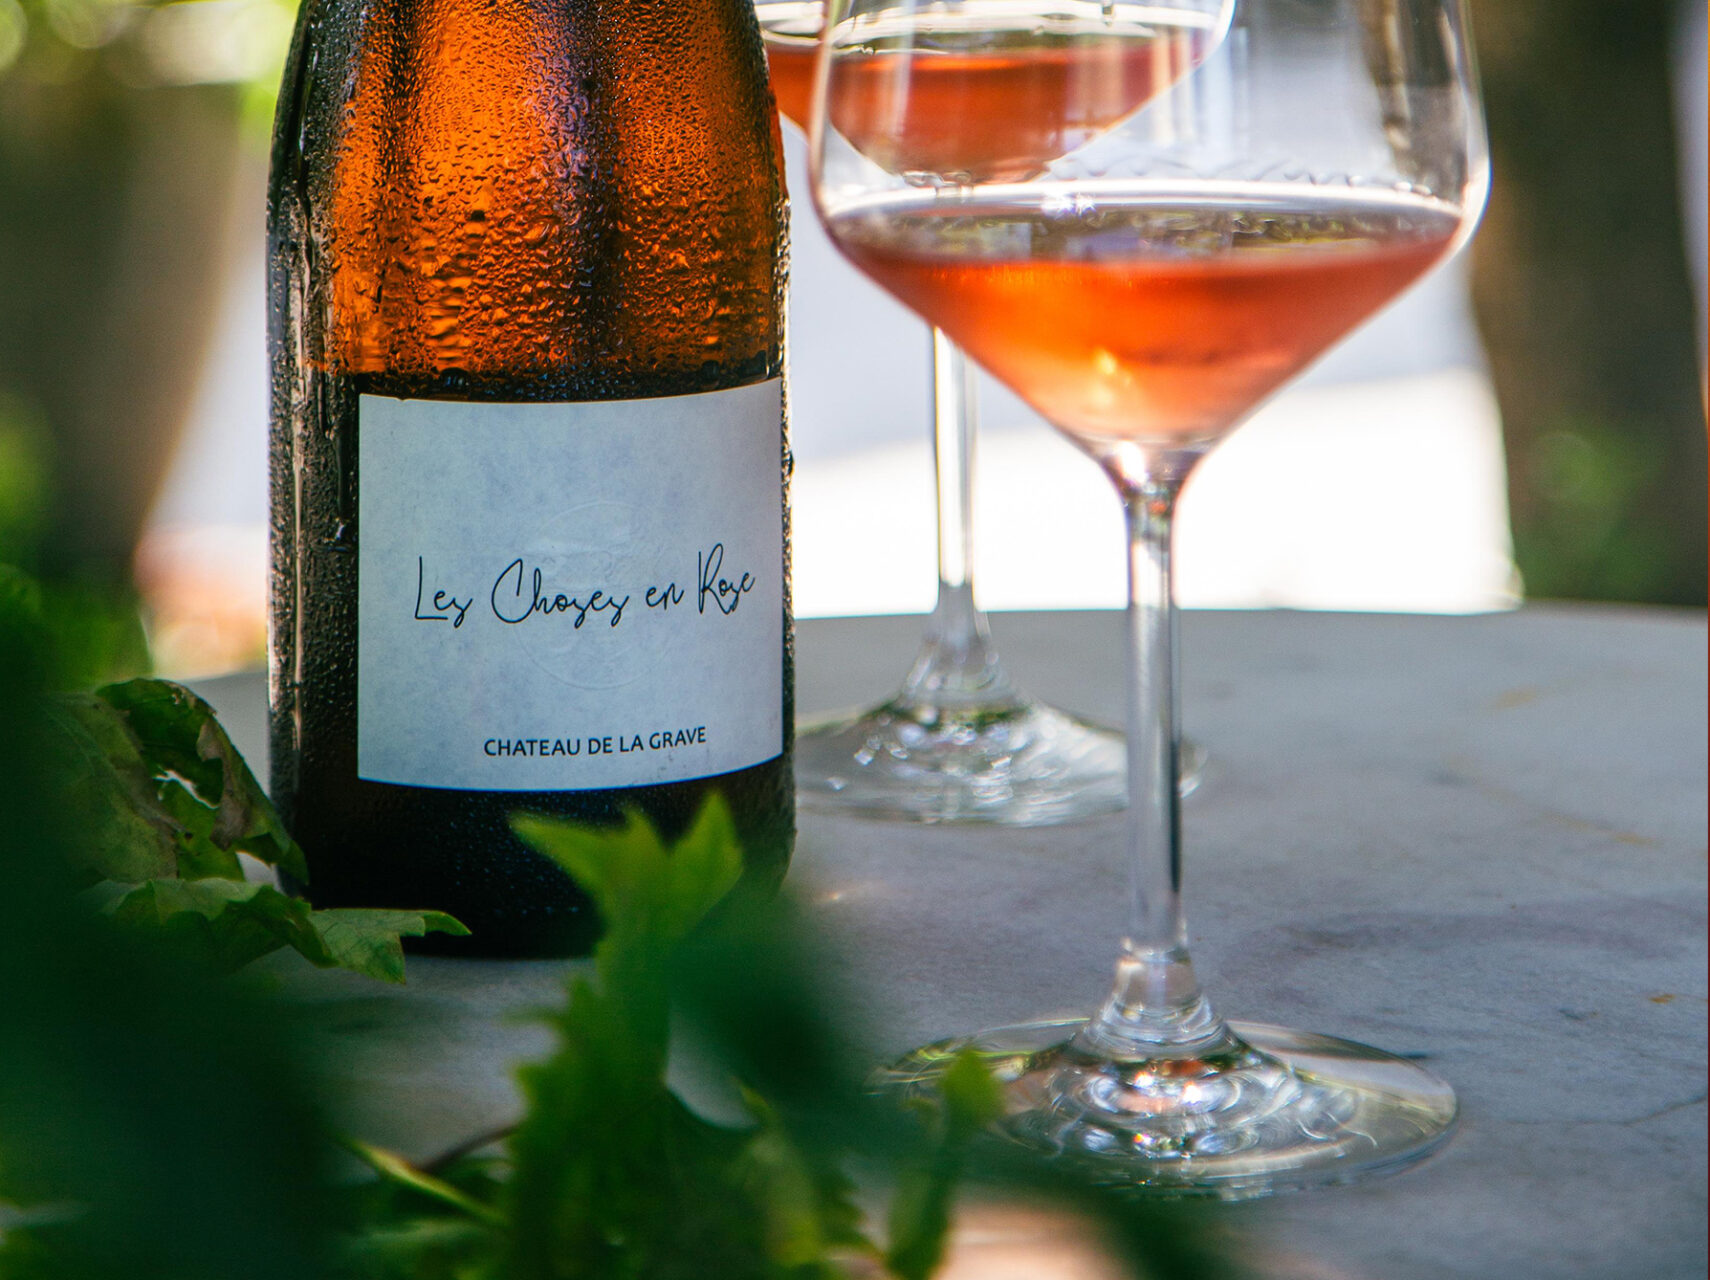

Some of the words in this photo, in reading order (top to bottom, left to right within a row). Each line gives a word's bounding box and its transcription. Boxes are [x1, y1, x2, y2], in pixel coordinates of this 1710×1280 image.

[414, 555, 473, 629] Les
[490, 558, 630, 629] Choses
[645, 582, 685, 610] en
[698, 543, 756, 615] Rose
[483, 738, 581, 757] CHATEAU
[587, 736, 613, 755] DE
[619, 734, 644, 752] LA
[648, 726, 707, 750] GRAVE
